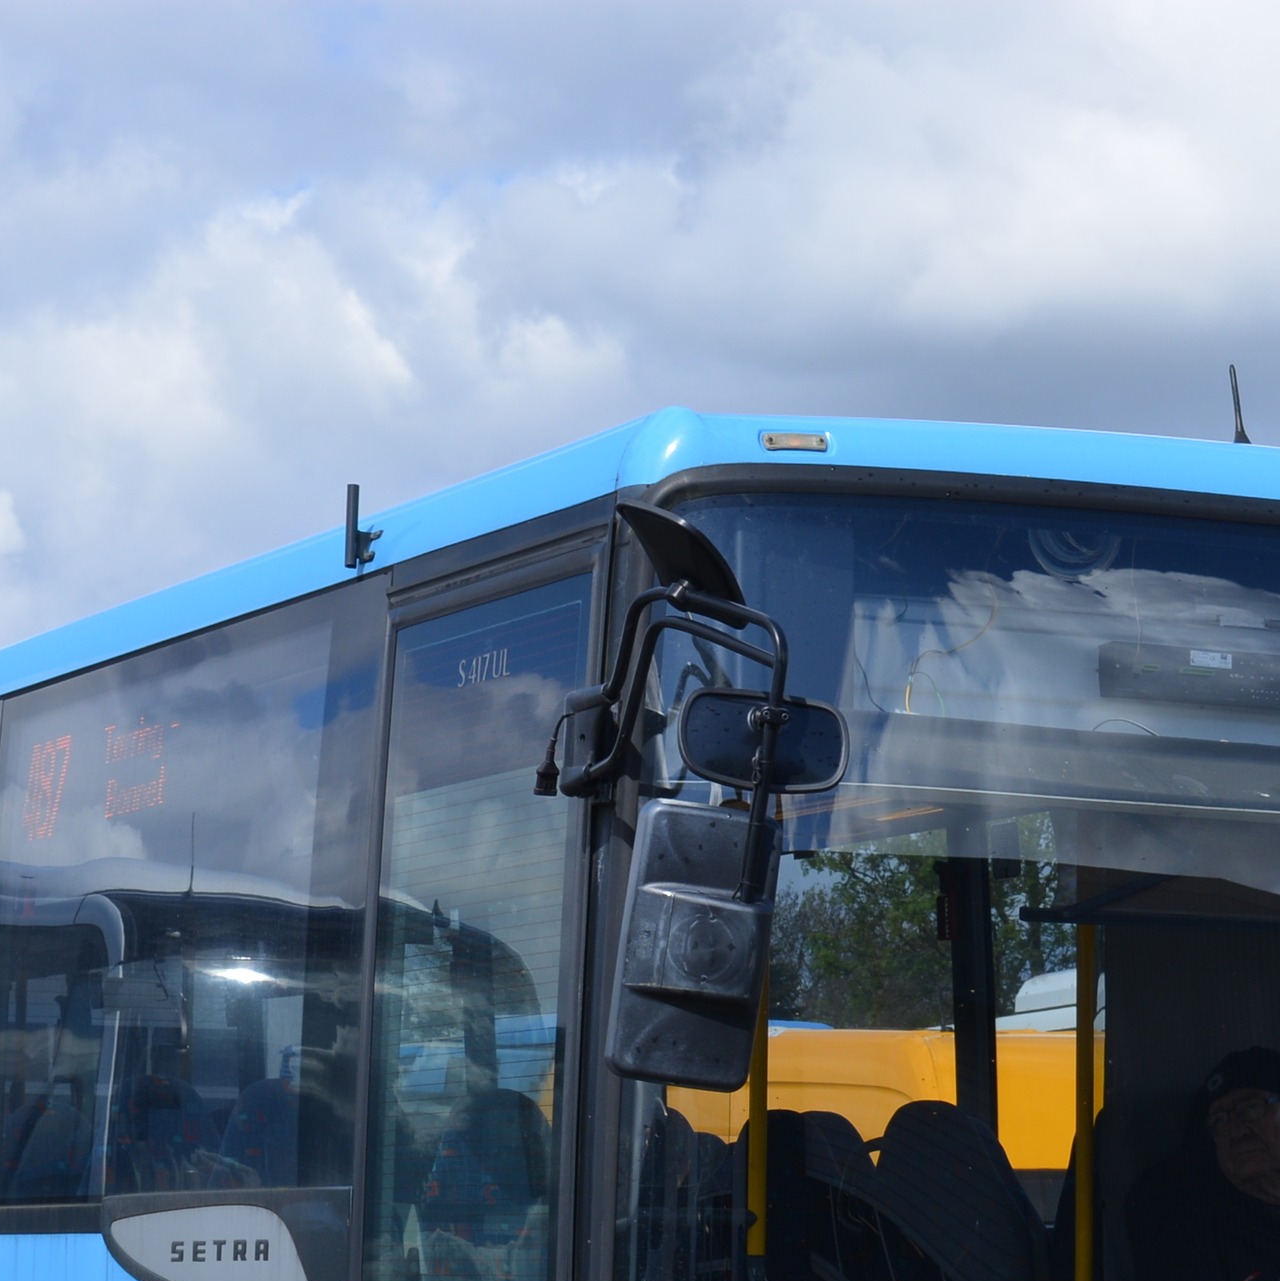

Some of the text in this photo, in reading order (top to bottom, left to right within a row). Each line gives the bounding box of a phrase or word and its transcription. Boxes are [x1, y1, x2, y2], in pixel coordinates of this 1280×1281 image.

[457, 648, 511, 688] S 417 UL
[171, 1239, 270, 1262] SETRA
